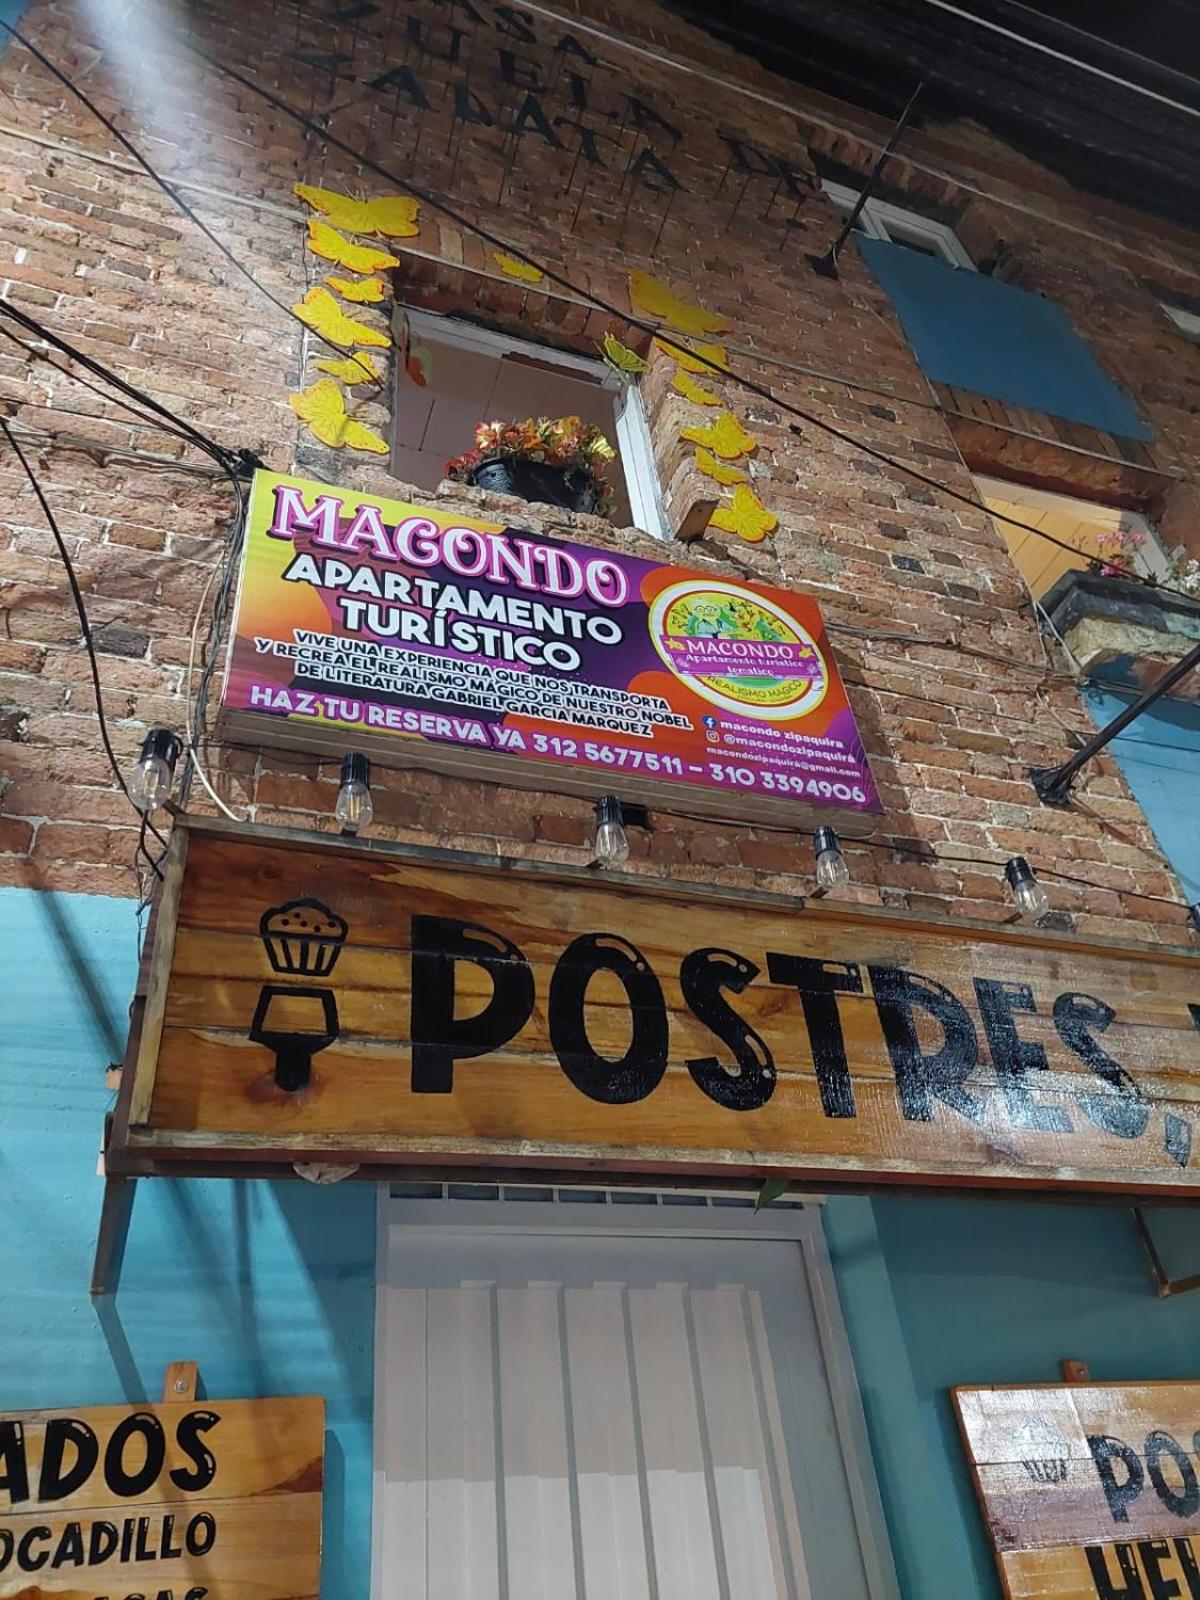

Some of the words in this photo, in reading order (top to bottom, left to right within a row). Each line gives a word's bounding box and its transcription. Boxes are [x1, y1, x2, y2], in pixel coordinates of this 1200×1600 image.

[270, 486, 628, 606] MACONDO
[284, 553, 623, 645] APARTAMENTO
[339, 598, 581, 672] TURÍSTICO
[256, 638, 272, 651] Y
[277, 643, 348, 666] RECREA
[352, 657, 374, 670] EL
[379, 661, 466, 687] REALISMO
[470, 678, 539, 701] MÁGICO
[542, 692, 562, 706] DE
[567, 697, 638, 719] NUESTRO
[641, 706, 692, 729] NOBEL
[296, 630, 335, 648] VIVE
[341, 639, 379, 657] UNA
[384, 645, 491, 678] EXPERIENCIA
[495, 669, 530, 685] QUE
[535, 676, 569, 692] NOS
[572, 683, 669, 710] TRANSPORTA
[686, 639, 794, 660] MACONDO
[706, 675, 767, 699] REALISMO
[250, 685, 315, 714] HAZ
[324, 697, 360, 721] TU
[368, 704, 487, 743] RESERVA
[492, 726, 527, 750] YA
[533, 733, 578, 759] 312
[584, 741, 683, 776] 5677511
[708, 762, 756, 787] 310
[298, 662, 319, 677] DE
[325, 667, 427, 696] LITERATURA
[431, 687, 501, 710] GABRIEL
[506, 701, 569, 722] GARCIA
[572, 714, 652, 736] MARQUEZ
[720, 720, 781, 738] macondo
[1086, 1430, 1200, 1524] PO
